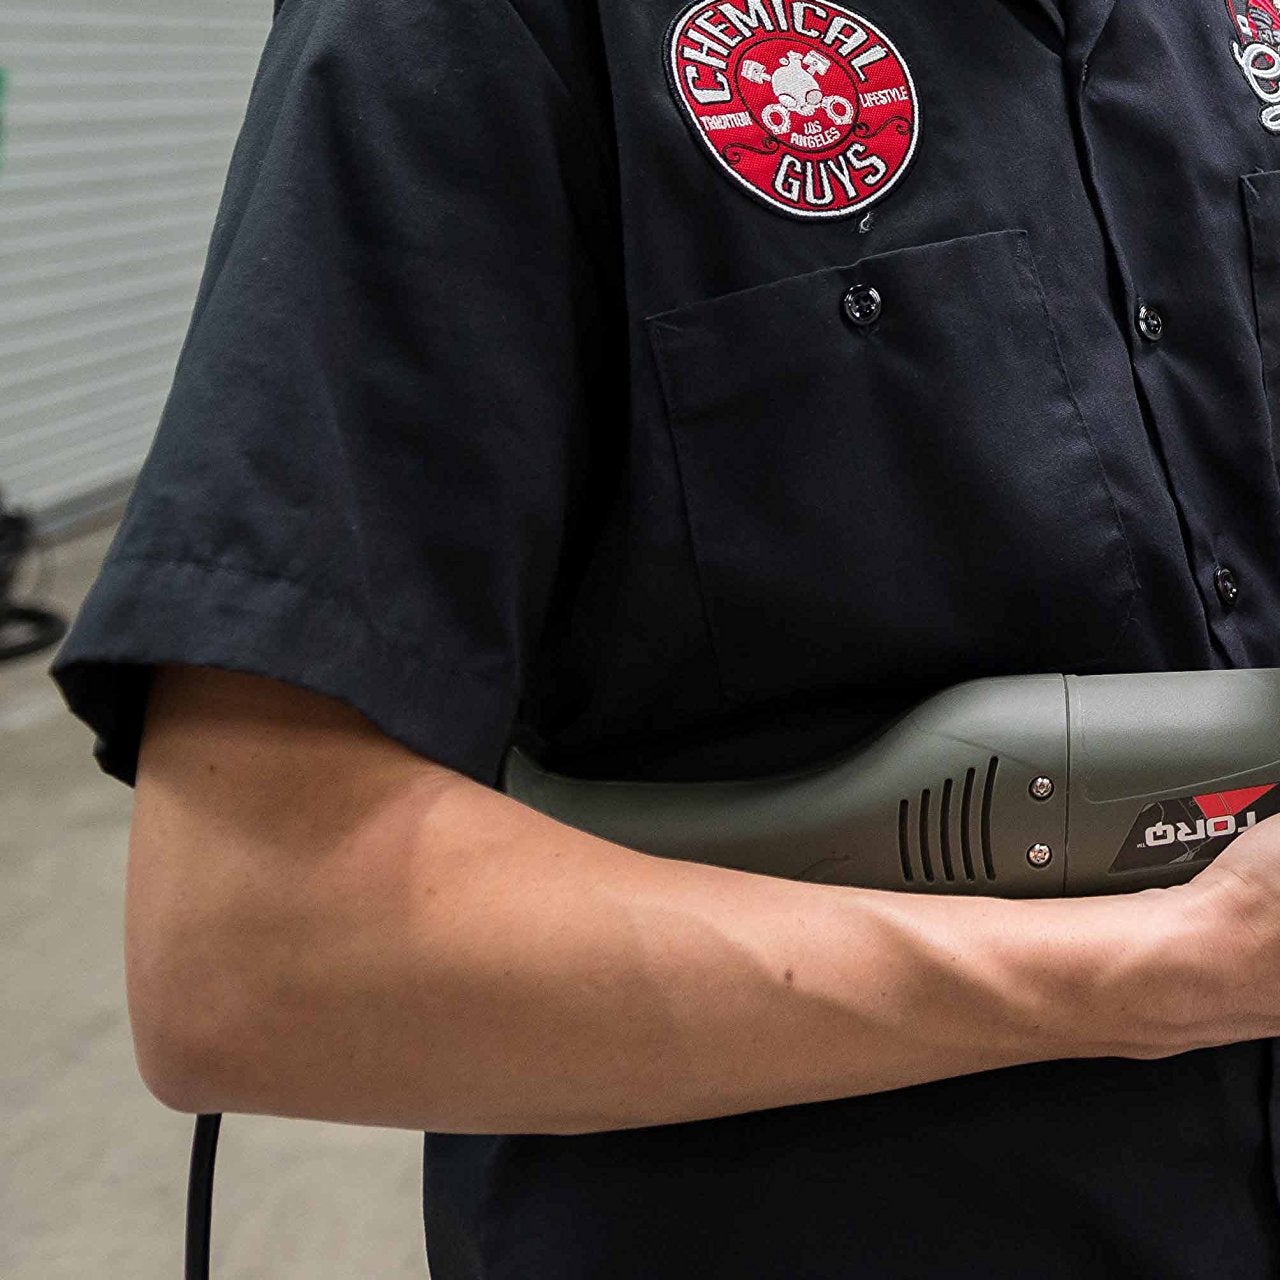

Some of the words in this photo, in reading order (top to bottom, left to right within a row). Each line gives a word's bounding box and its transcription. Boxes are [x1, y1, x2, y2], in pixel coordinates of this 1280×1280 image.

[860, 86, 908, 107] LIFESTYLE
[790, 127, 840, 149] ANGELES
[804, 120, 822, 135] LOS
[774, 142, 887, 206] GUYS
[1145, 811, 1256, 847] TORQ
